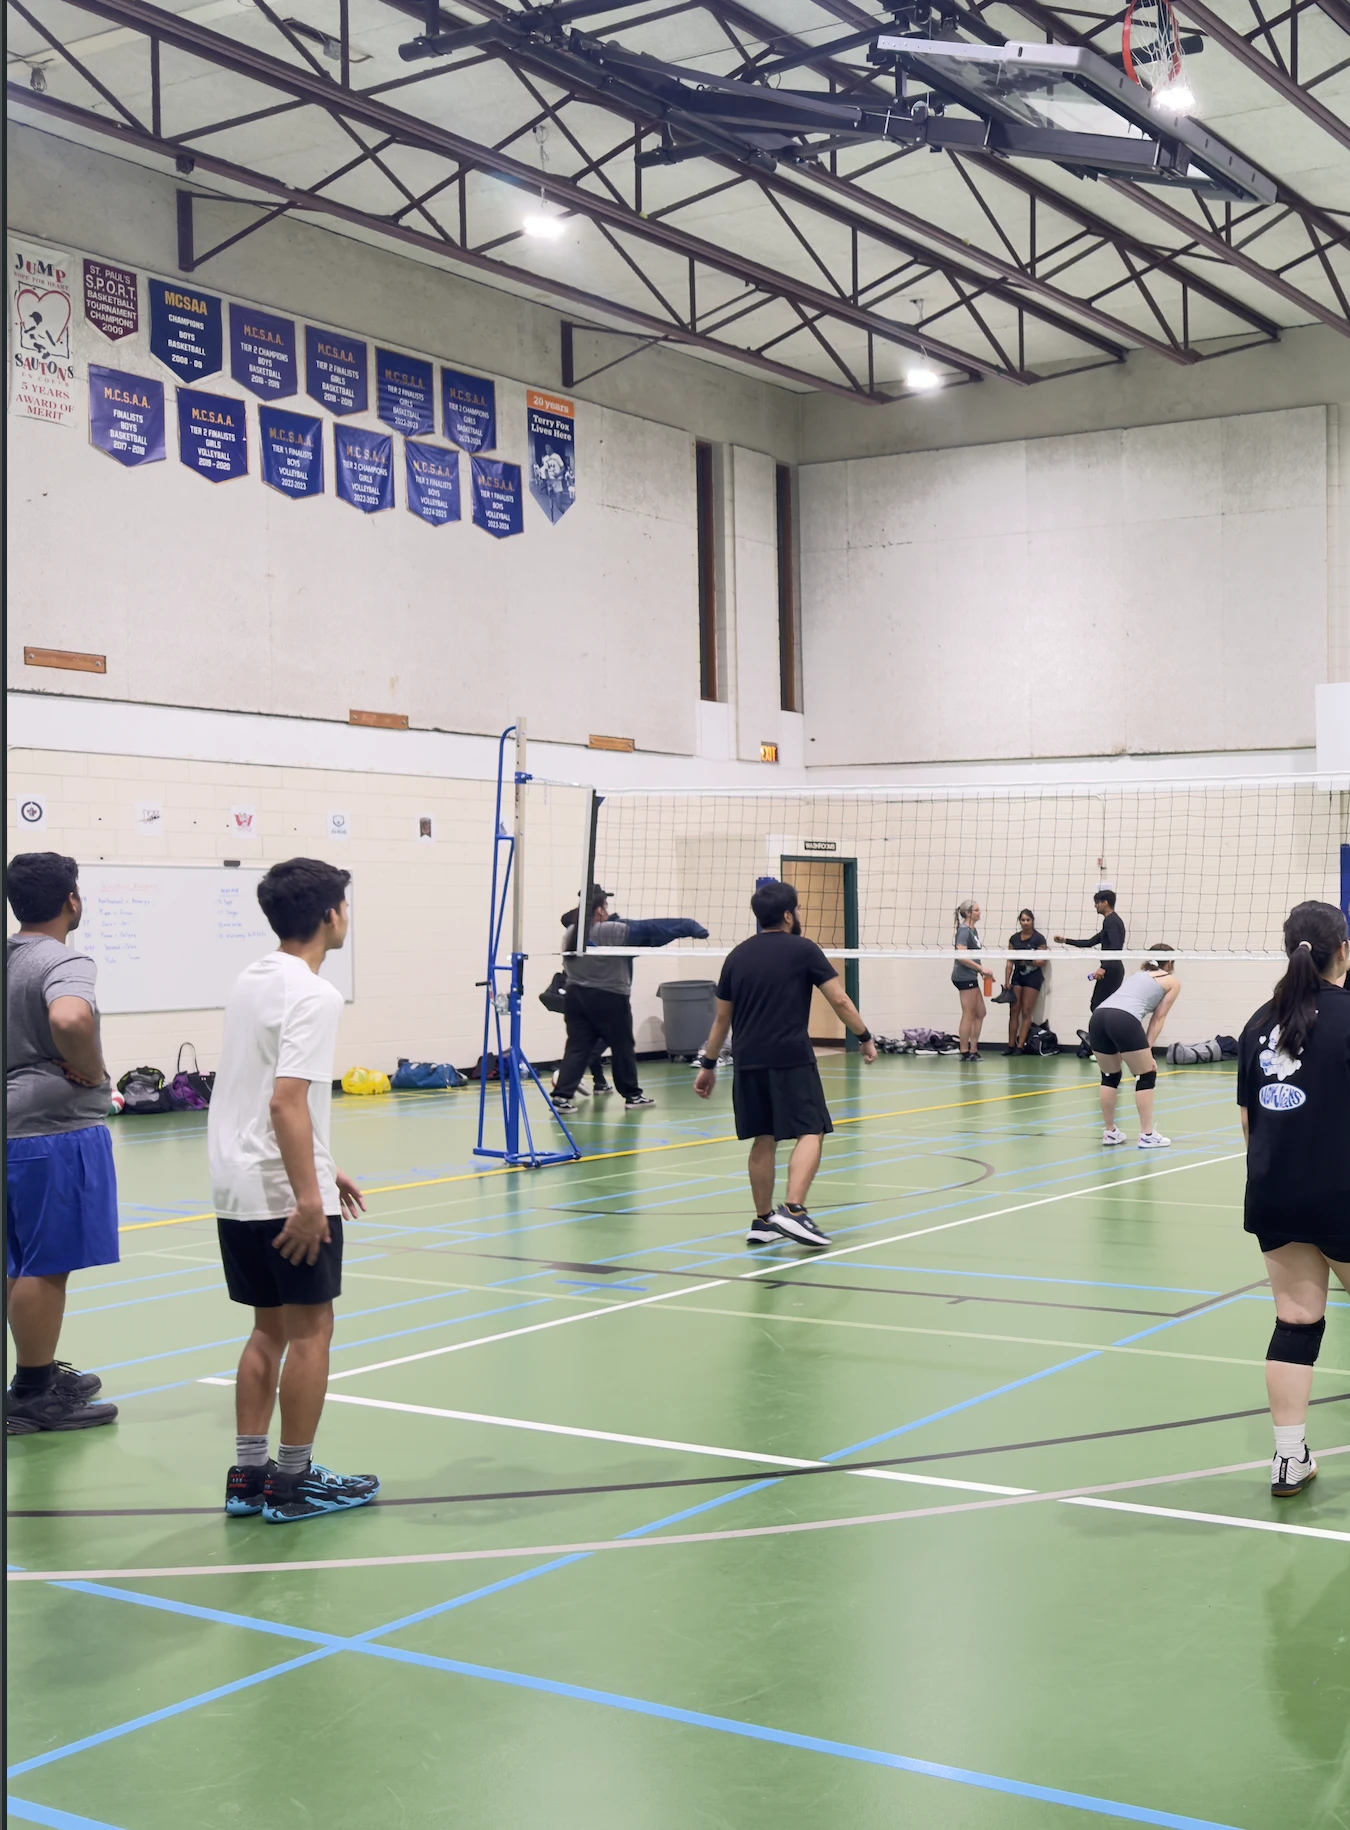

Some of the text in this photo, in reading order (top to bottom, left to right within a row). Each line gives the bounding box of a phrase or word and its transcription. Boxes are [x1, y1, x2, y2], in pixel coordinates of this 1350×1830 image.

[15, 253, 66, 283] JUMP
[90, 265, 131, 285] ST. PAUL'S
[86, 275, 136, 300] S.P.O.R.T.
[88, 290, 135, 310] BASKETBALL
[165, 291, 208, 316] MCSAA
[86, 300, 137, 320] TOURNAMENT
[90, 310, 134, 329] CHAMPIONS
[169, 314, 204, 330] CHAMPIONS
[102, 323, 124, 335] 2009
[179, 331, 195, 341] BOYS
[244, 324, 284, 345] M.C.S.A.A.
[168, 339, 206, 356] BASKETBALL
[241, 342, 288, 363] TIER 2 CHAMPIONS
[318, 343, 355, 364] M.C.S.A.A.
[15, 353, 73, 381] SAUTONS
[258, 357, 272, 367] BOYS
[316, 360, 359, 380] TIER 2 FINALISTS
[249, 364, 281, 380] BASKETBALL
[331, 375, 346, 385] GIRLS
[22, 382, 69, 399] 5 YEARS
[105, 387, 151, 409] M.C.S.A.A.
[322, 382, 355, 398] BASKETBALL
[388, 385, 398, 394] TIER
[402, 389, 425, 401] FINALISTS
[16, 394, 74, 413] AWARD OF
[534, 396, 569, 413] 20 years
[28, 405, 63, 420] MERIT
[114, 409, 144, 423] FINALISTS
[192, 408, 234, 427] M.C.S.A.A.
[393, 407, 420, 420] BASKETBALL
[463, 406, 490, 419] CHAMPIONS
[121, 421, 137, 432] BOYS
[457, 424, 483, 437] BASKETBALL
[533, 415, 570, 431] Terry Fox
[110, 429, 147, 445] BASKETBALL
[190, 426, 236, 442] TIER 2 FINALISTS
[269, 427, 314, 447] M.C.S.A.A.
[531, 424, 572, 442] Lives Here
[114, 441, 127, 451] 2017
[206, 439, 221, 449] GIRLS
[272, 444, 284, 453] TIER
[289, 448, 313, 460] FINALISTS
[198, 448, 231, 461] VOLLEYBALL
[287, 458, 300, 467] BOYS
[279, 467, 308, 480] VOLLEYBALL
[343, 460, 353, 469] TIER
[358, 464, 388, 476] CHAMPIONS
[359, 474, 373, 484] GIRLS
[430, 479, 452, 490] FINALISTS
[352, 483, 380, 495] VOLLEYBALL
[421, 496, 448, 508] VOLLEYBALL
[485, 510, 511, 521] VOLLEYBALL
